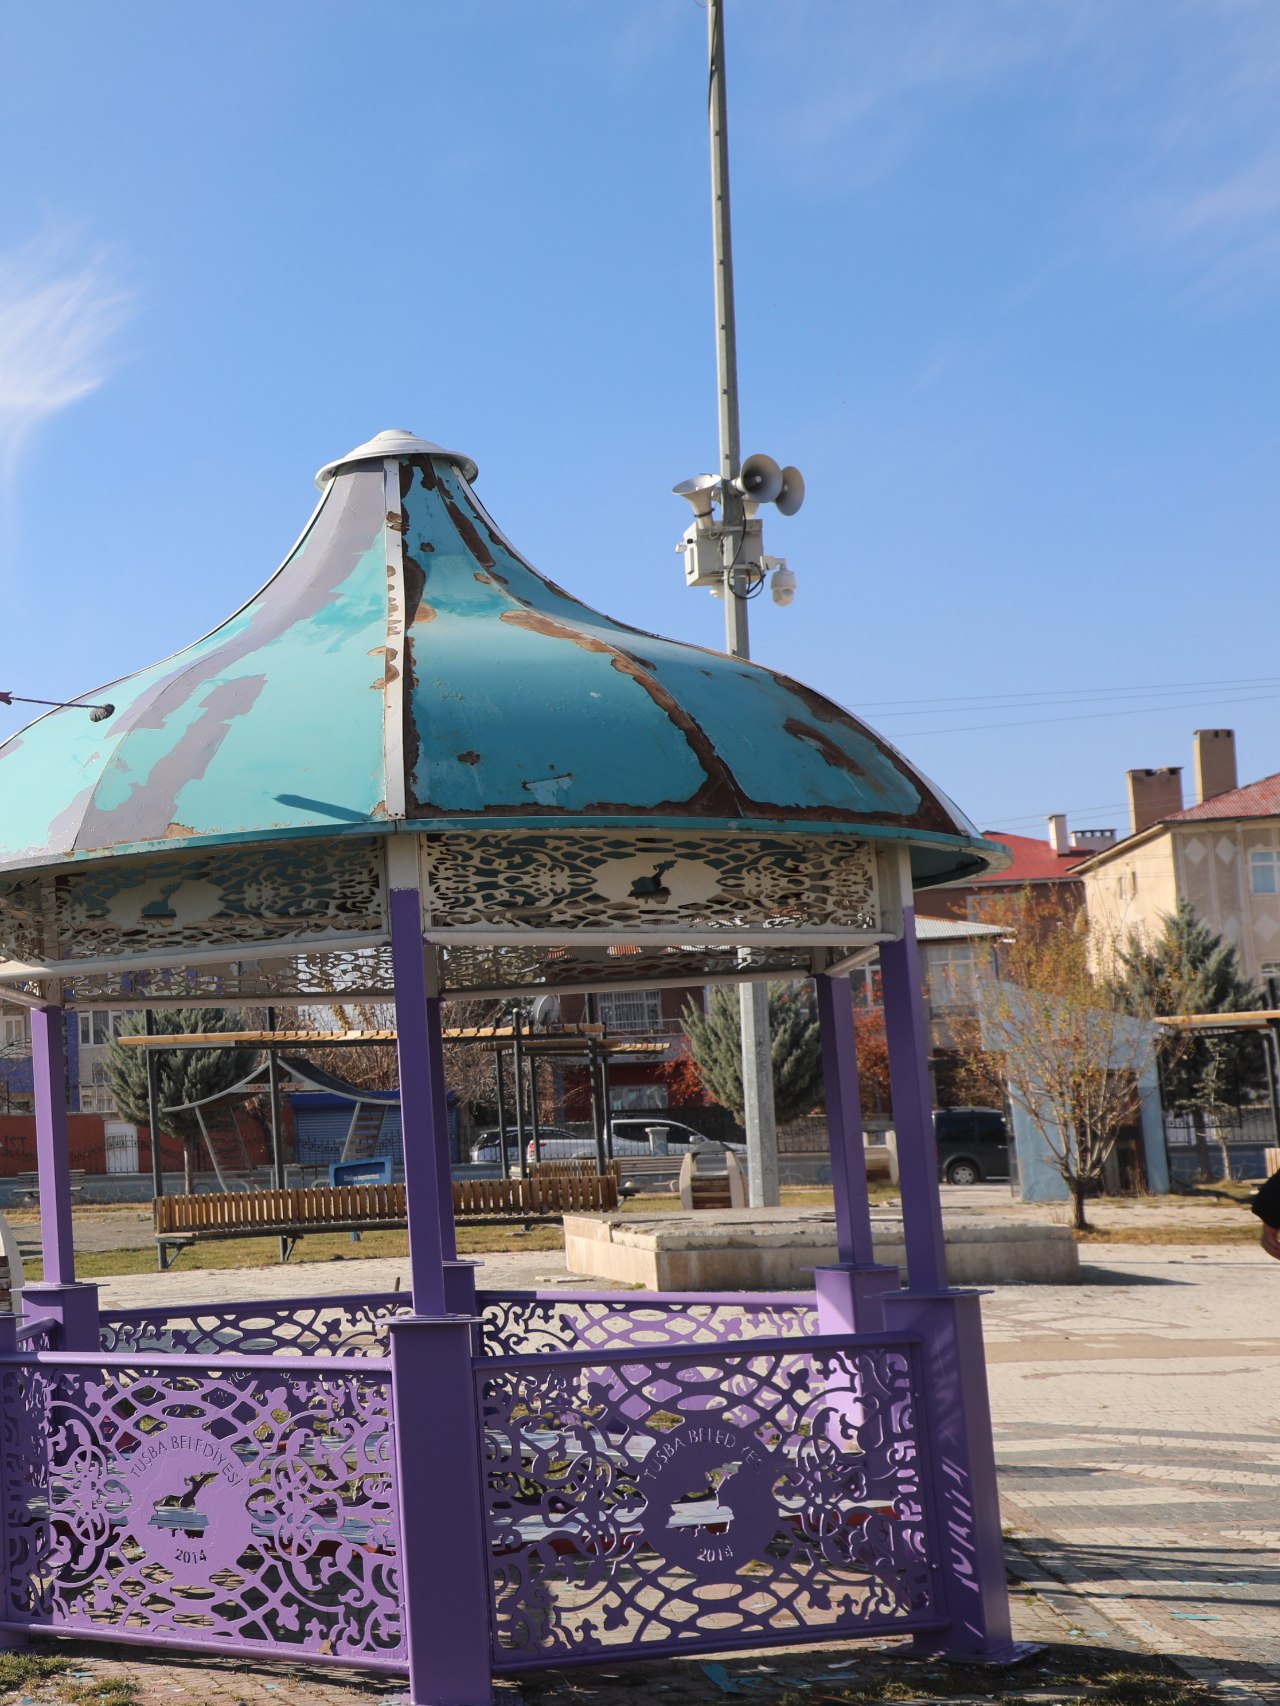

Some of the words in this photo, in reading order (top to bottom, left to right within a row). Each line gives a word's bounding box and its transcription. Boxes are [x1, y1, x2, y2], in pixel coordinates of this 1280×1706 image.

[131, 1441, 168, 1479] TUŞBA
[171, 1435, 244, 1488] BELEDİYESİ
[174, 1548, 207, 1564] 2014
[697, 1545, 734, 1562] 2014
